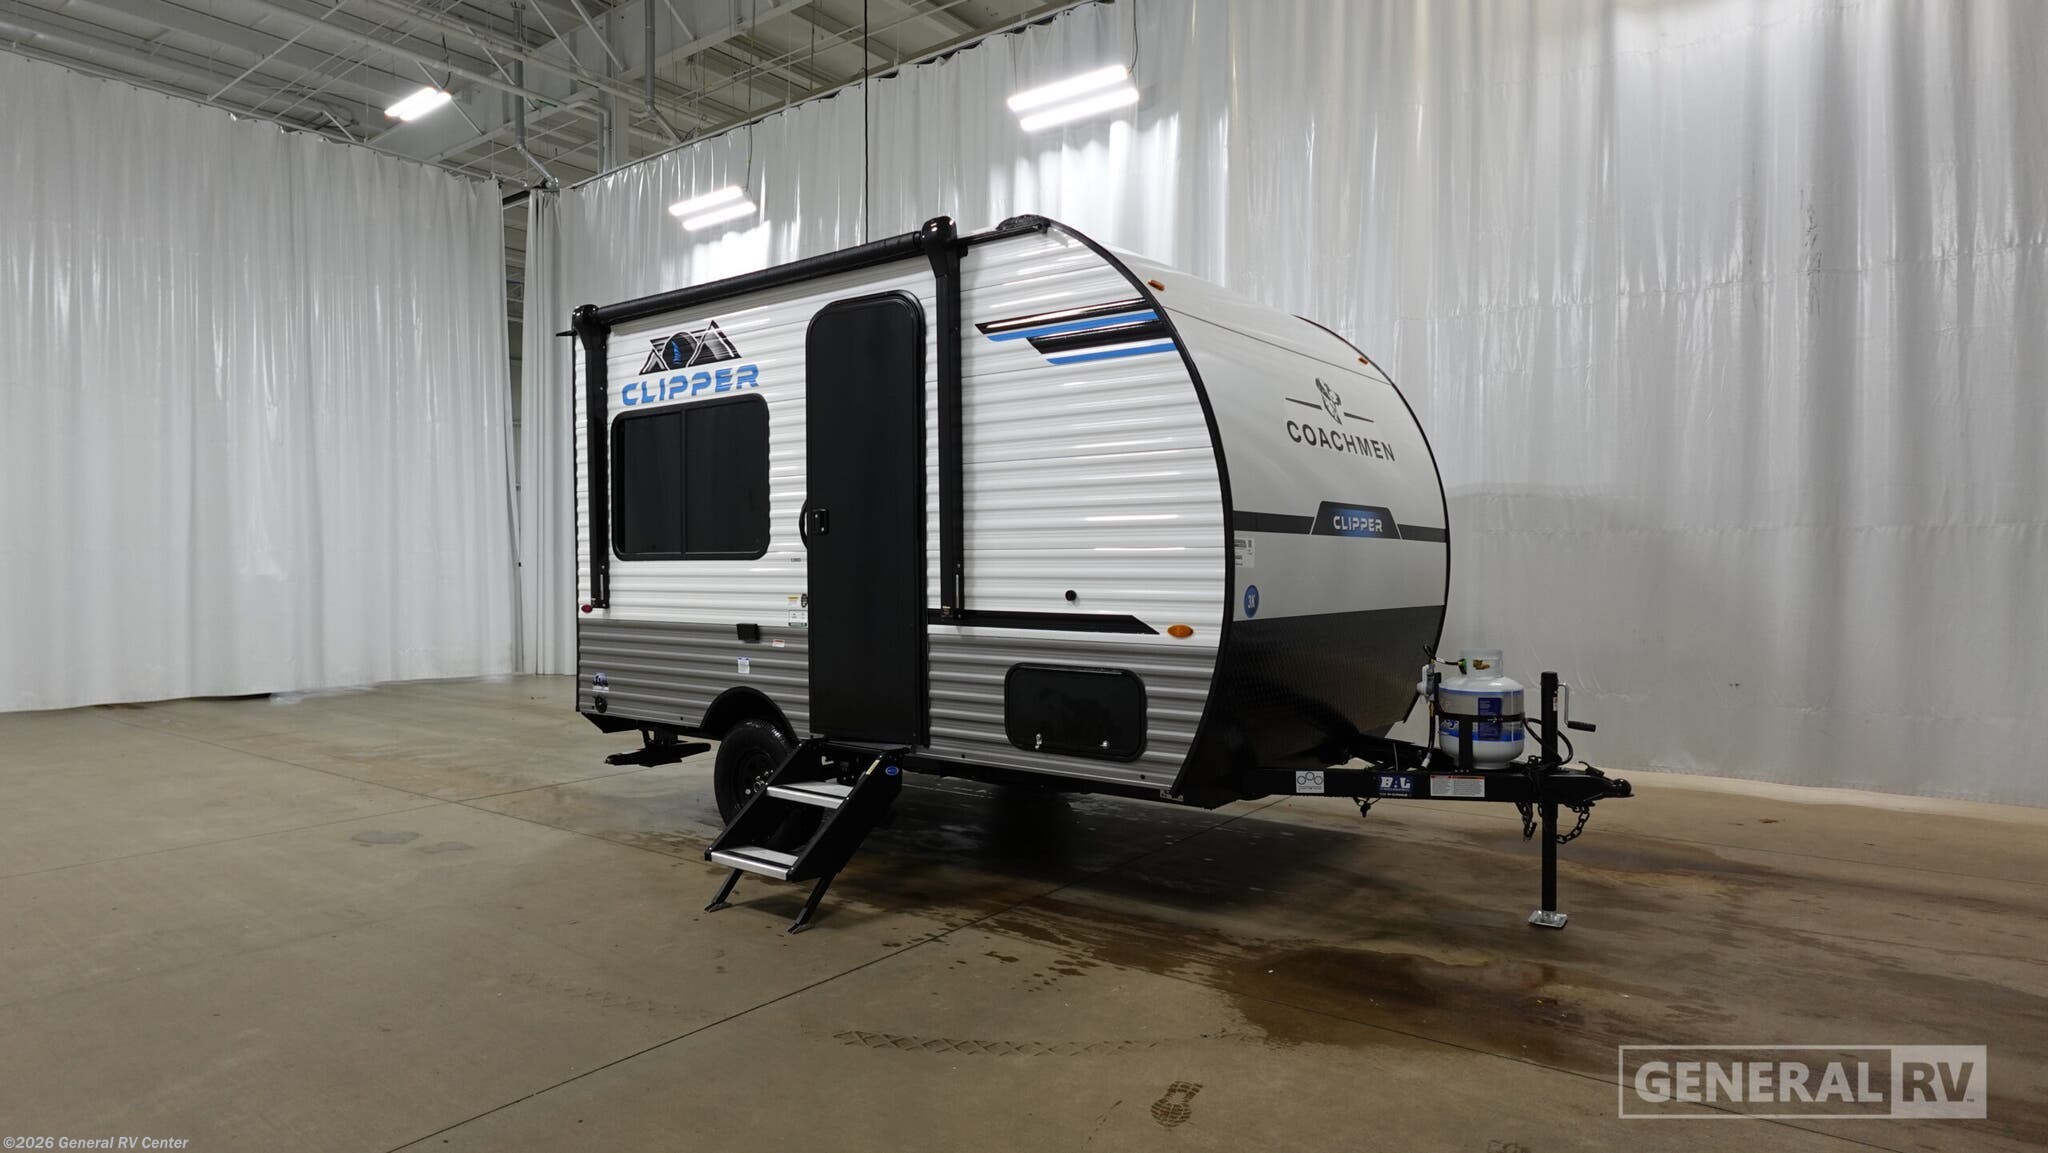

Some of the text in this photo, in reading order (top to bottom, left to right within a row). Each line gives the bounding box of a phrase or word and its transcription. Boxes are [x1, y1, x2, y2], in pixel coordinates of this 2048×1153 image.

[621, 364, 760, 406] CLIPPER
[1286, 420, 1395, 462] COACHMEN
[1333, 516, 1383, 533] CLIPPER
